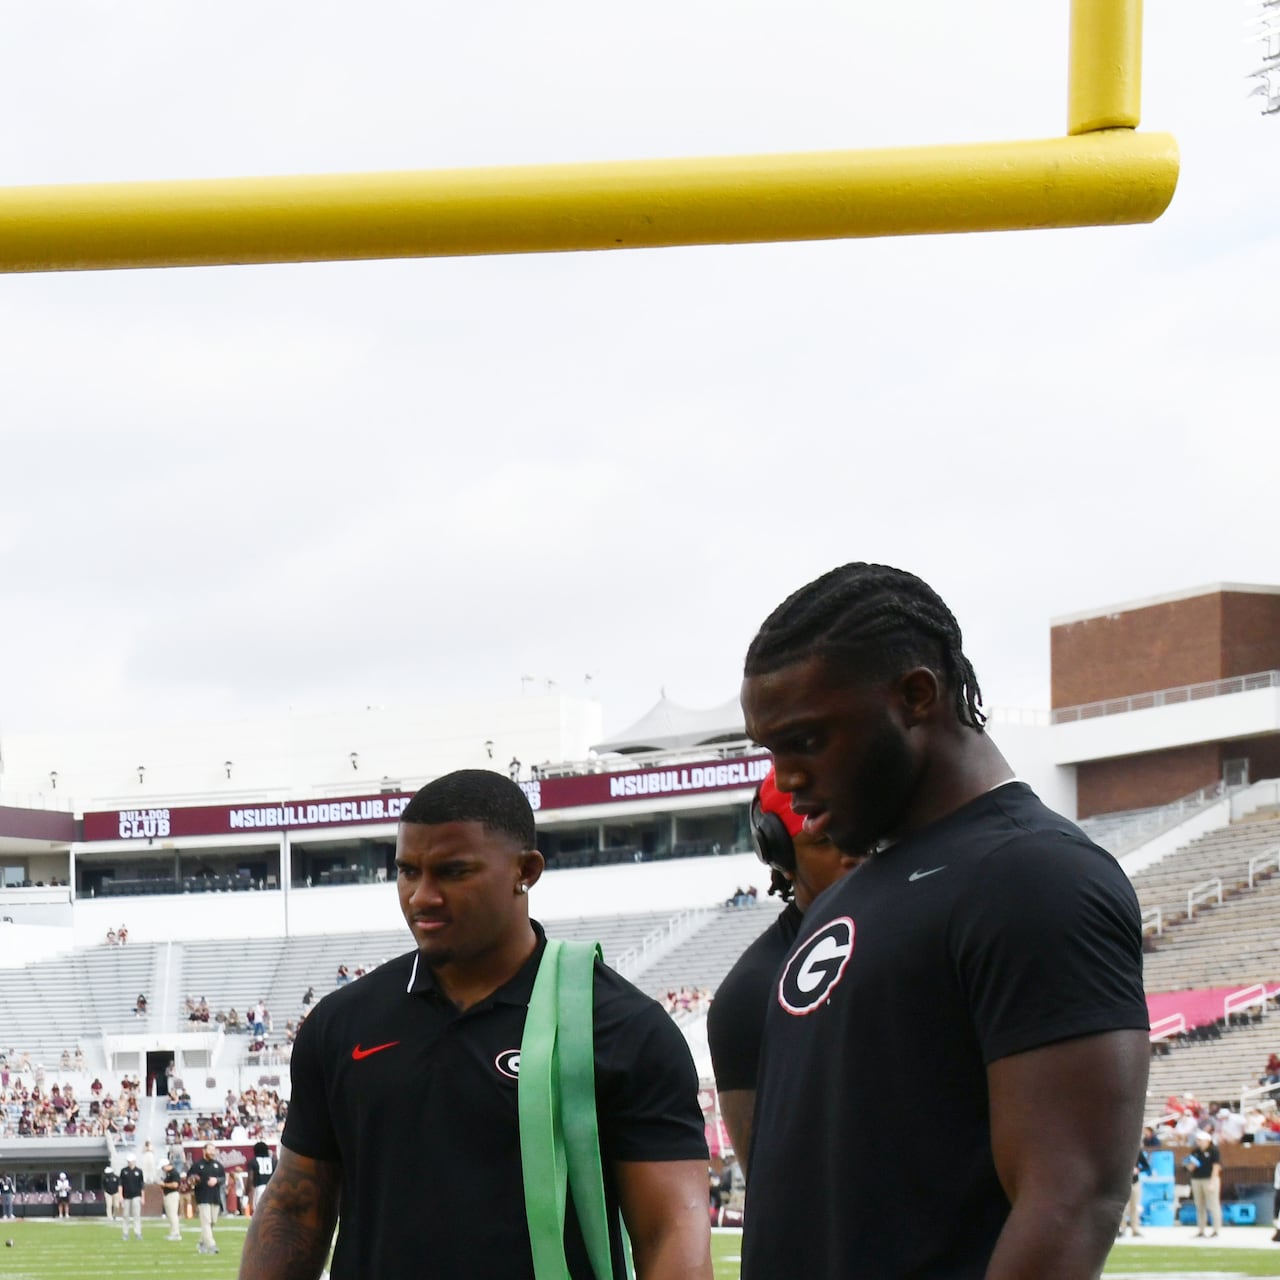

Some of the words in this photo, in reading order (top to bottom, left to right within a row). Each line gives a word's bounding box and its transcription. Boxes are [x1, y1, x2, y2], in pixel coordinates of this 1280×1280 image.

[610, 759, 772, 798] MSUBULLDOGCLUB
[118, 809, 170, 823] BULLDOG
[229, 798, 411, 829] MSUBULLDOGCLUB.C
[118, 820, 171, 839] CLUB
[781, 921, 850, 1009] G
